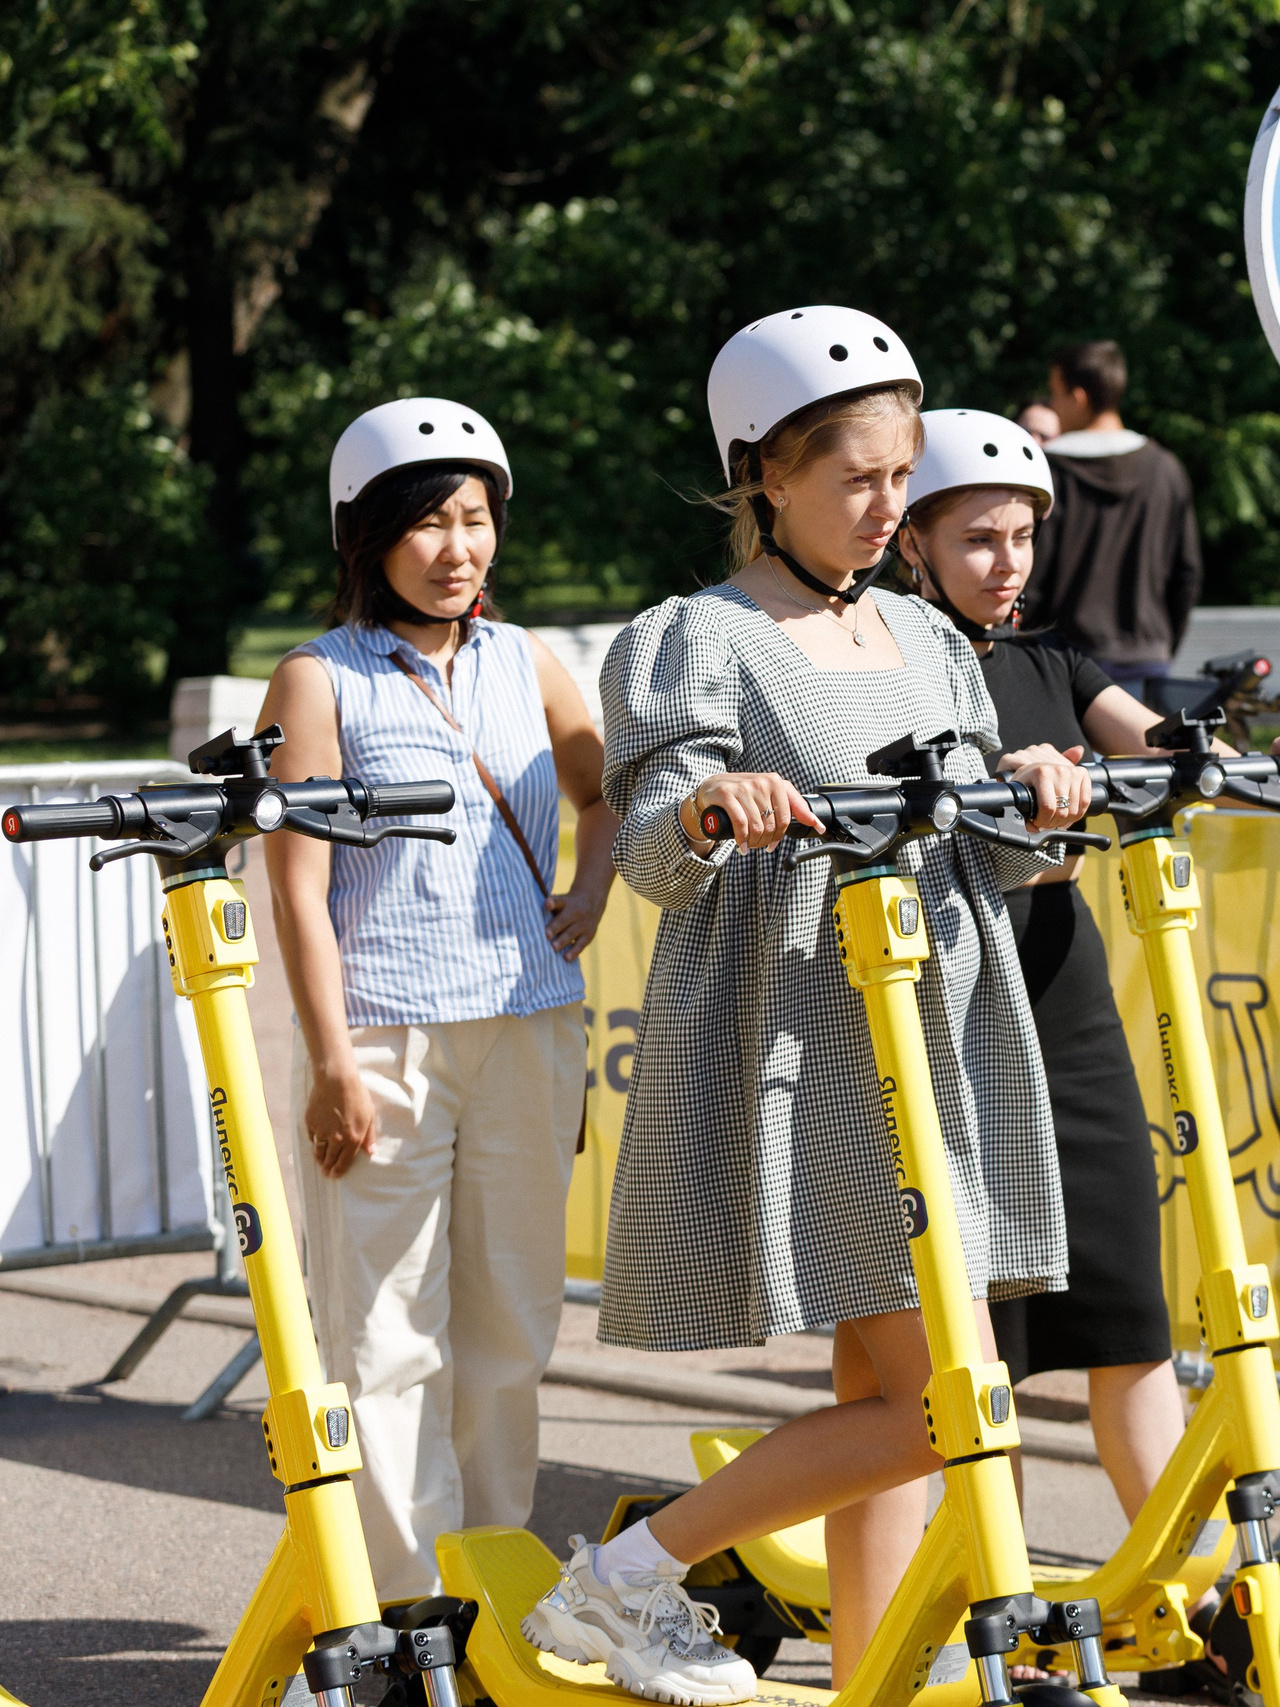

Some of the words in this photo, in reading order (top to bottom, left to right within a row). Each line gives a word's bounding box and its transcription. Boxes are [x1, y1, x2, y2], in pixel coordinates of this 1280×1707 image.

[8, 817, 16, 832] Я
[707, 816, 715, 830] Я
[1157, 1012, 1180, 1104] Яндекс
[1175, 1115, 1190, 1152] Go
[209, 1087, 239, 1197] Яндекс
[233, 1209, 251, 1252] Go
[878, 1075, 906, 1180] Яндекс
[901, 1193, 918, 1234] Go
